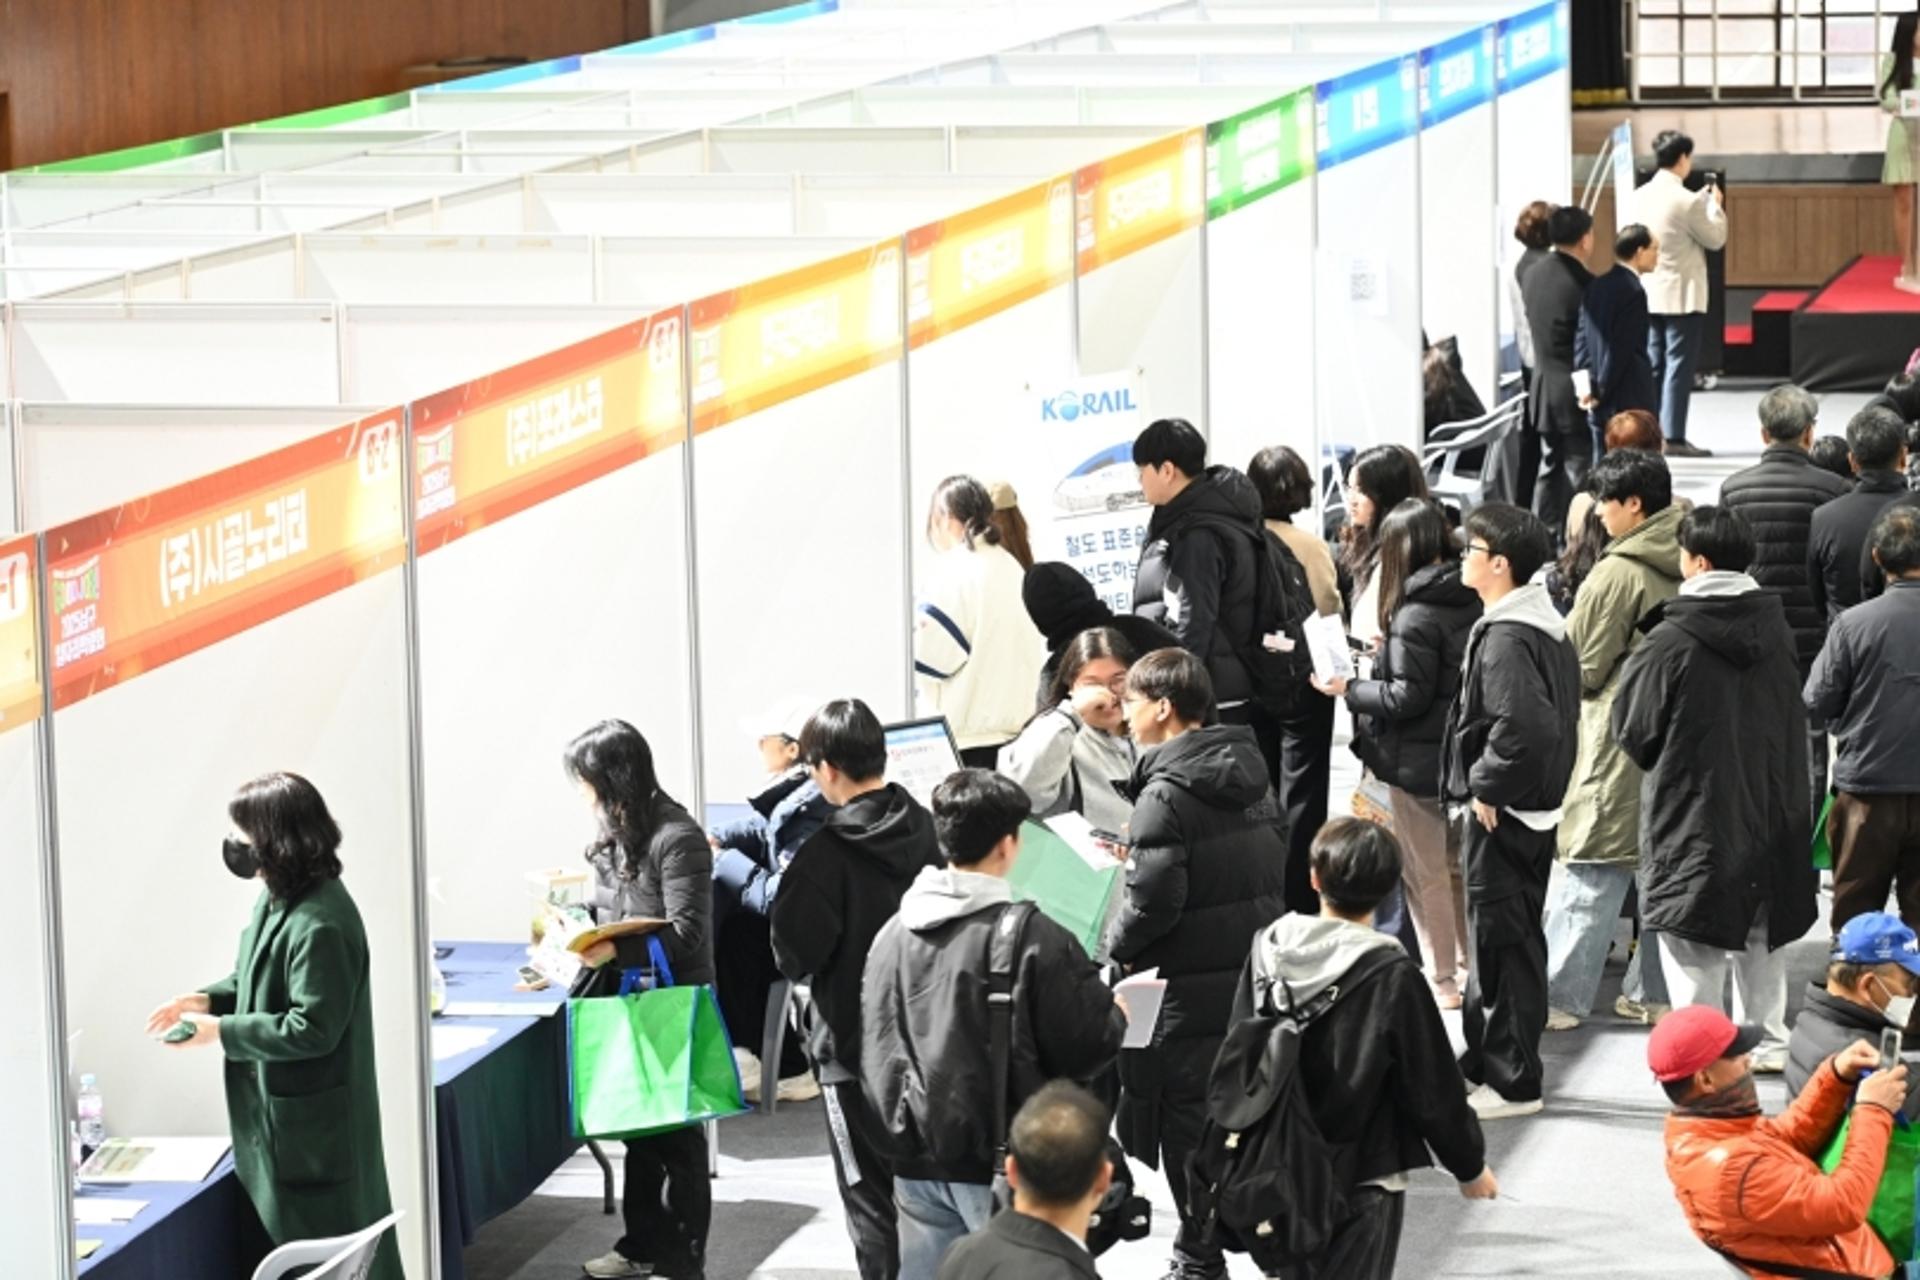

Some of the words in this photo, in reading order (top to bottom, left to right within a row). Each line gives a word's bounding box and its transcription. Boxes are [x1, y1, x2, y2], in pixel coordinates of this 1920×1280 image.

[1041, 388, 1137, 422] KORAIL
[160, 487, 309, 608] (주)시골노리터
[1065, 532, 1098, 557] 철도
